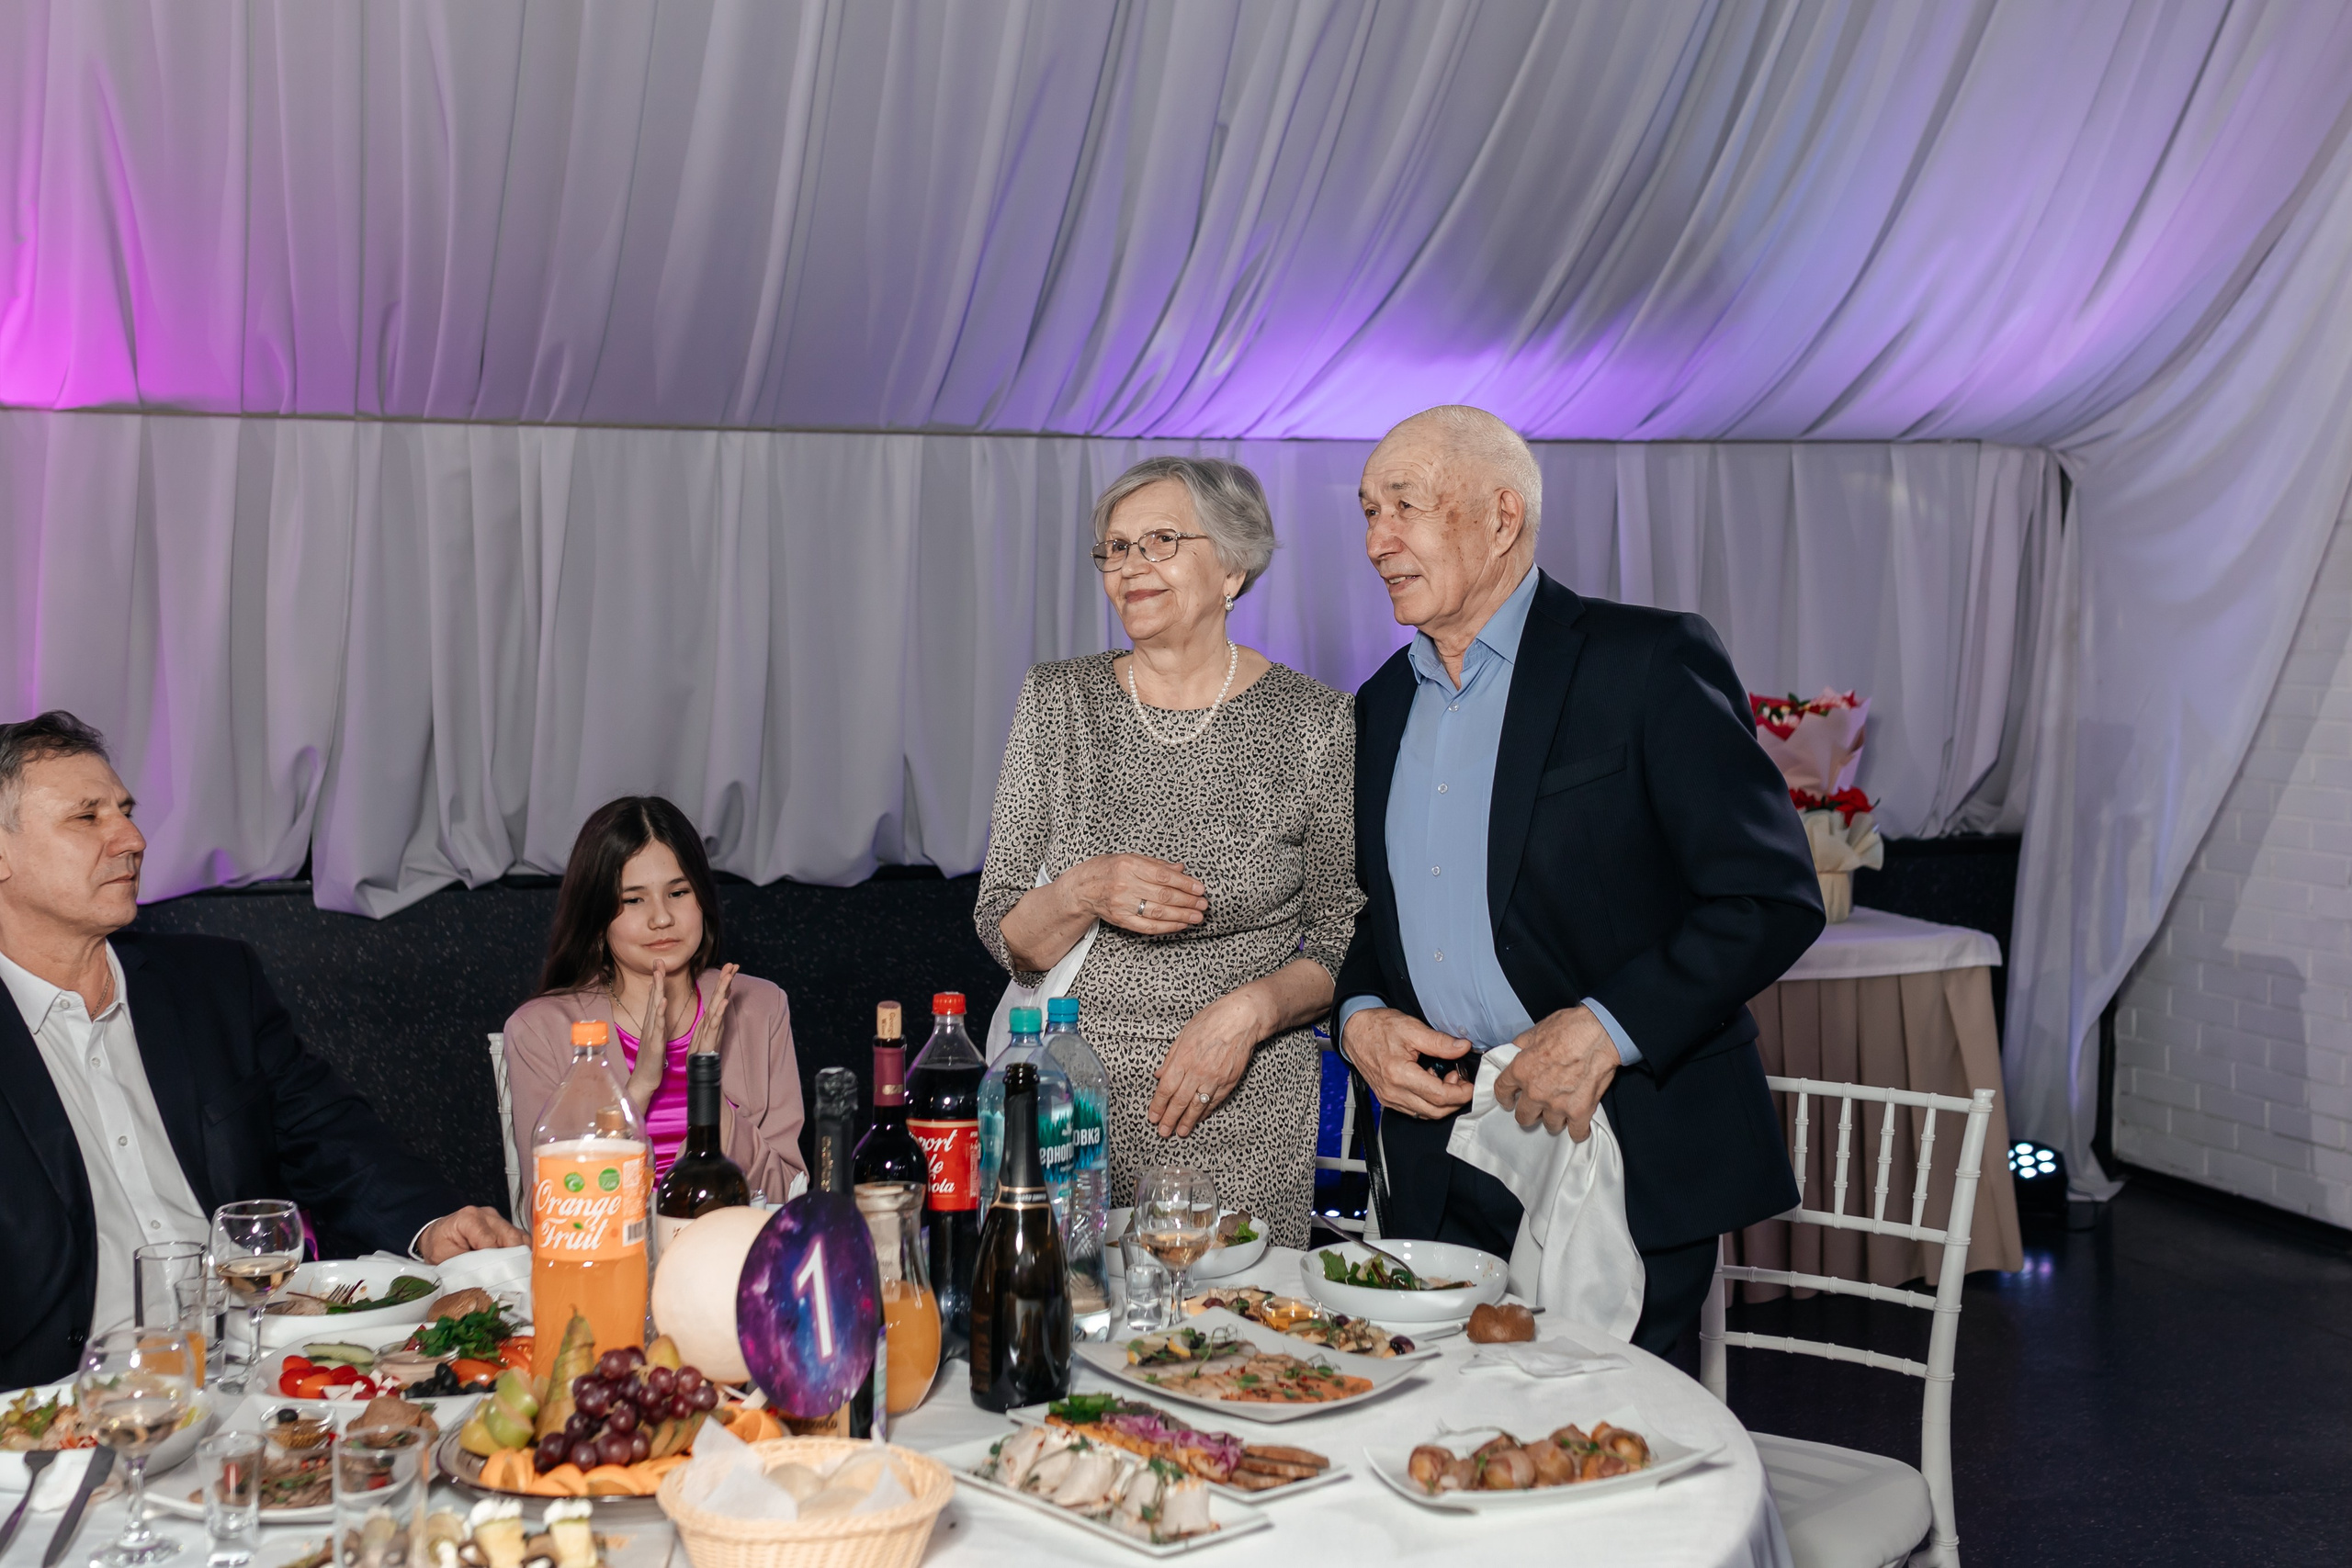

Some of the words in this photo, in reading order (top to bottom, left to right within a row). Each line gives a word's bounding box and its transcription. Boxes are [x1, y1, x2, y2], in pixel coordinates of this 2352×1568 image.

[1073, 1126, 1101, 1146] овка
[535, 1179, 622, 1228] Orange
[539, 1218, 609, 1249] Fruit
[796, 1241, 833, 1358] 1
